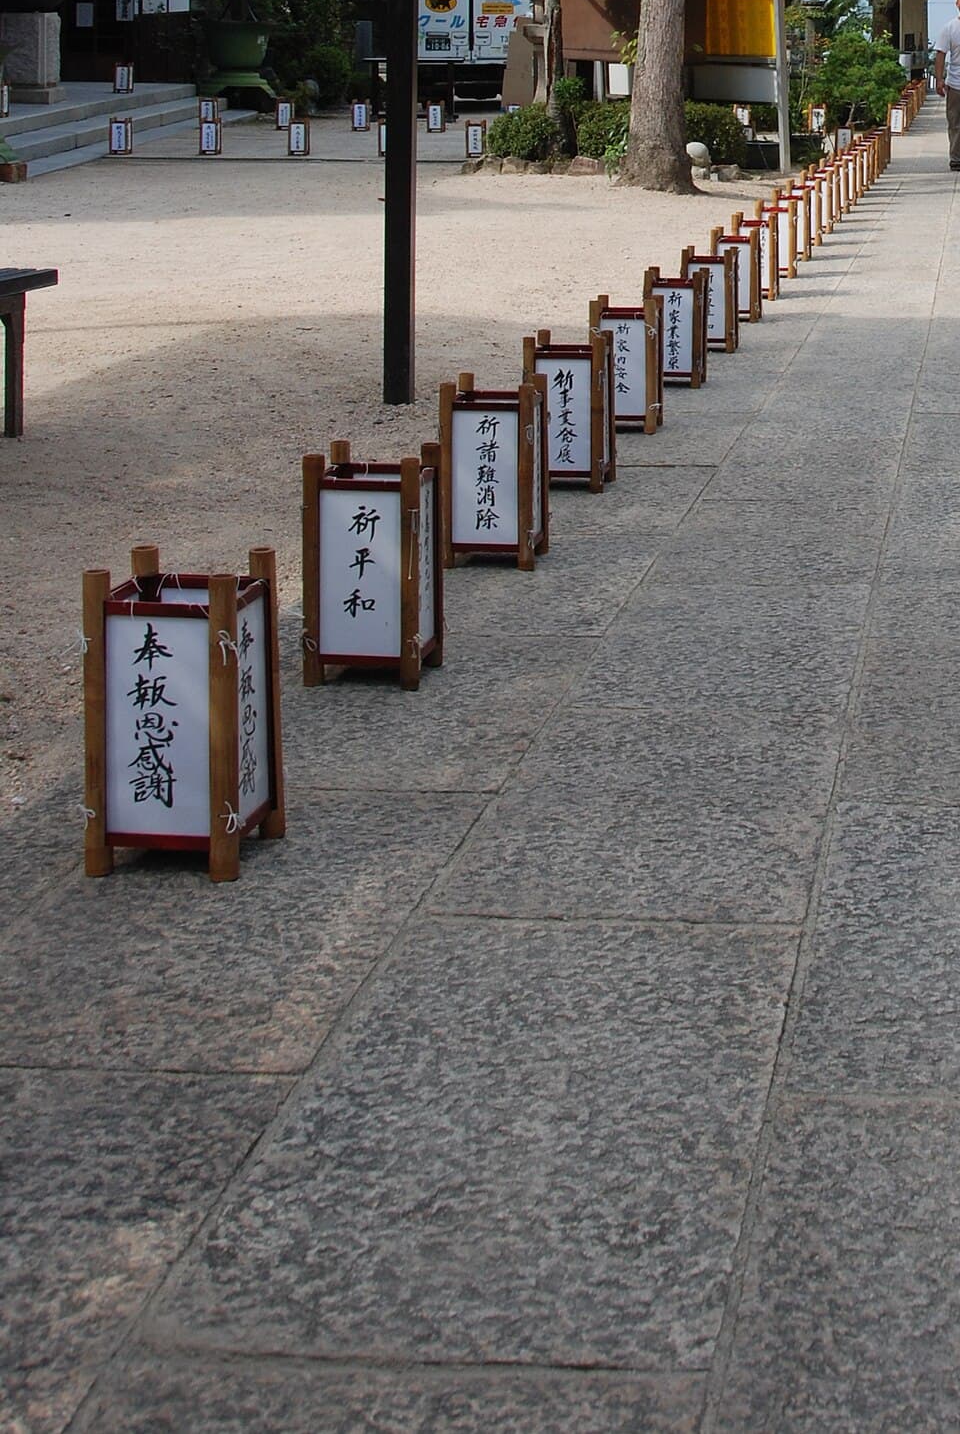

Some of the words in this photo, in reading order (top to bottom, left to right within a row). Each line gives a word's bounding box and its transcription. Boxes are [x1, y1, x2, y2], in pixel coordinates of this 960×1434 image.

[419, 15, 465, 29] クール
[475, 415, 501, 531] 祈諸難消除
[342, 505, 381, 619] 祈平和
[127, 621, 179, 808] 奉報恩感謝
